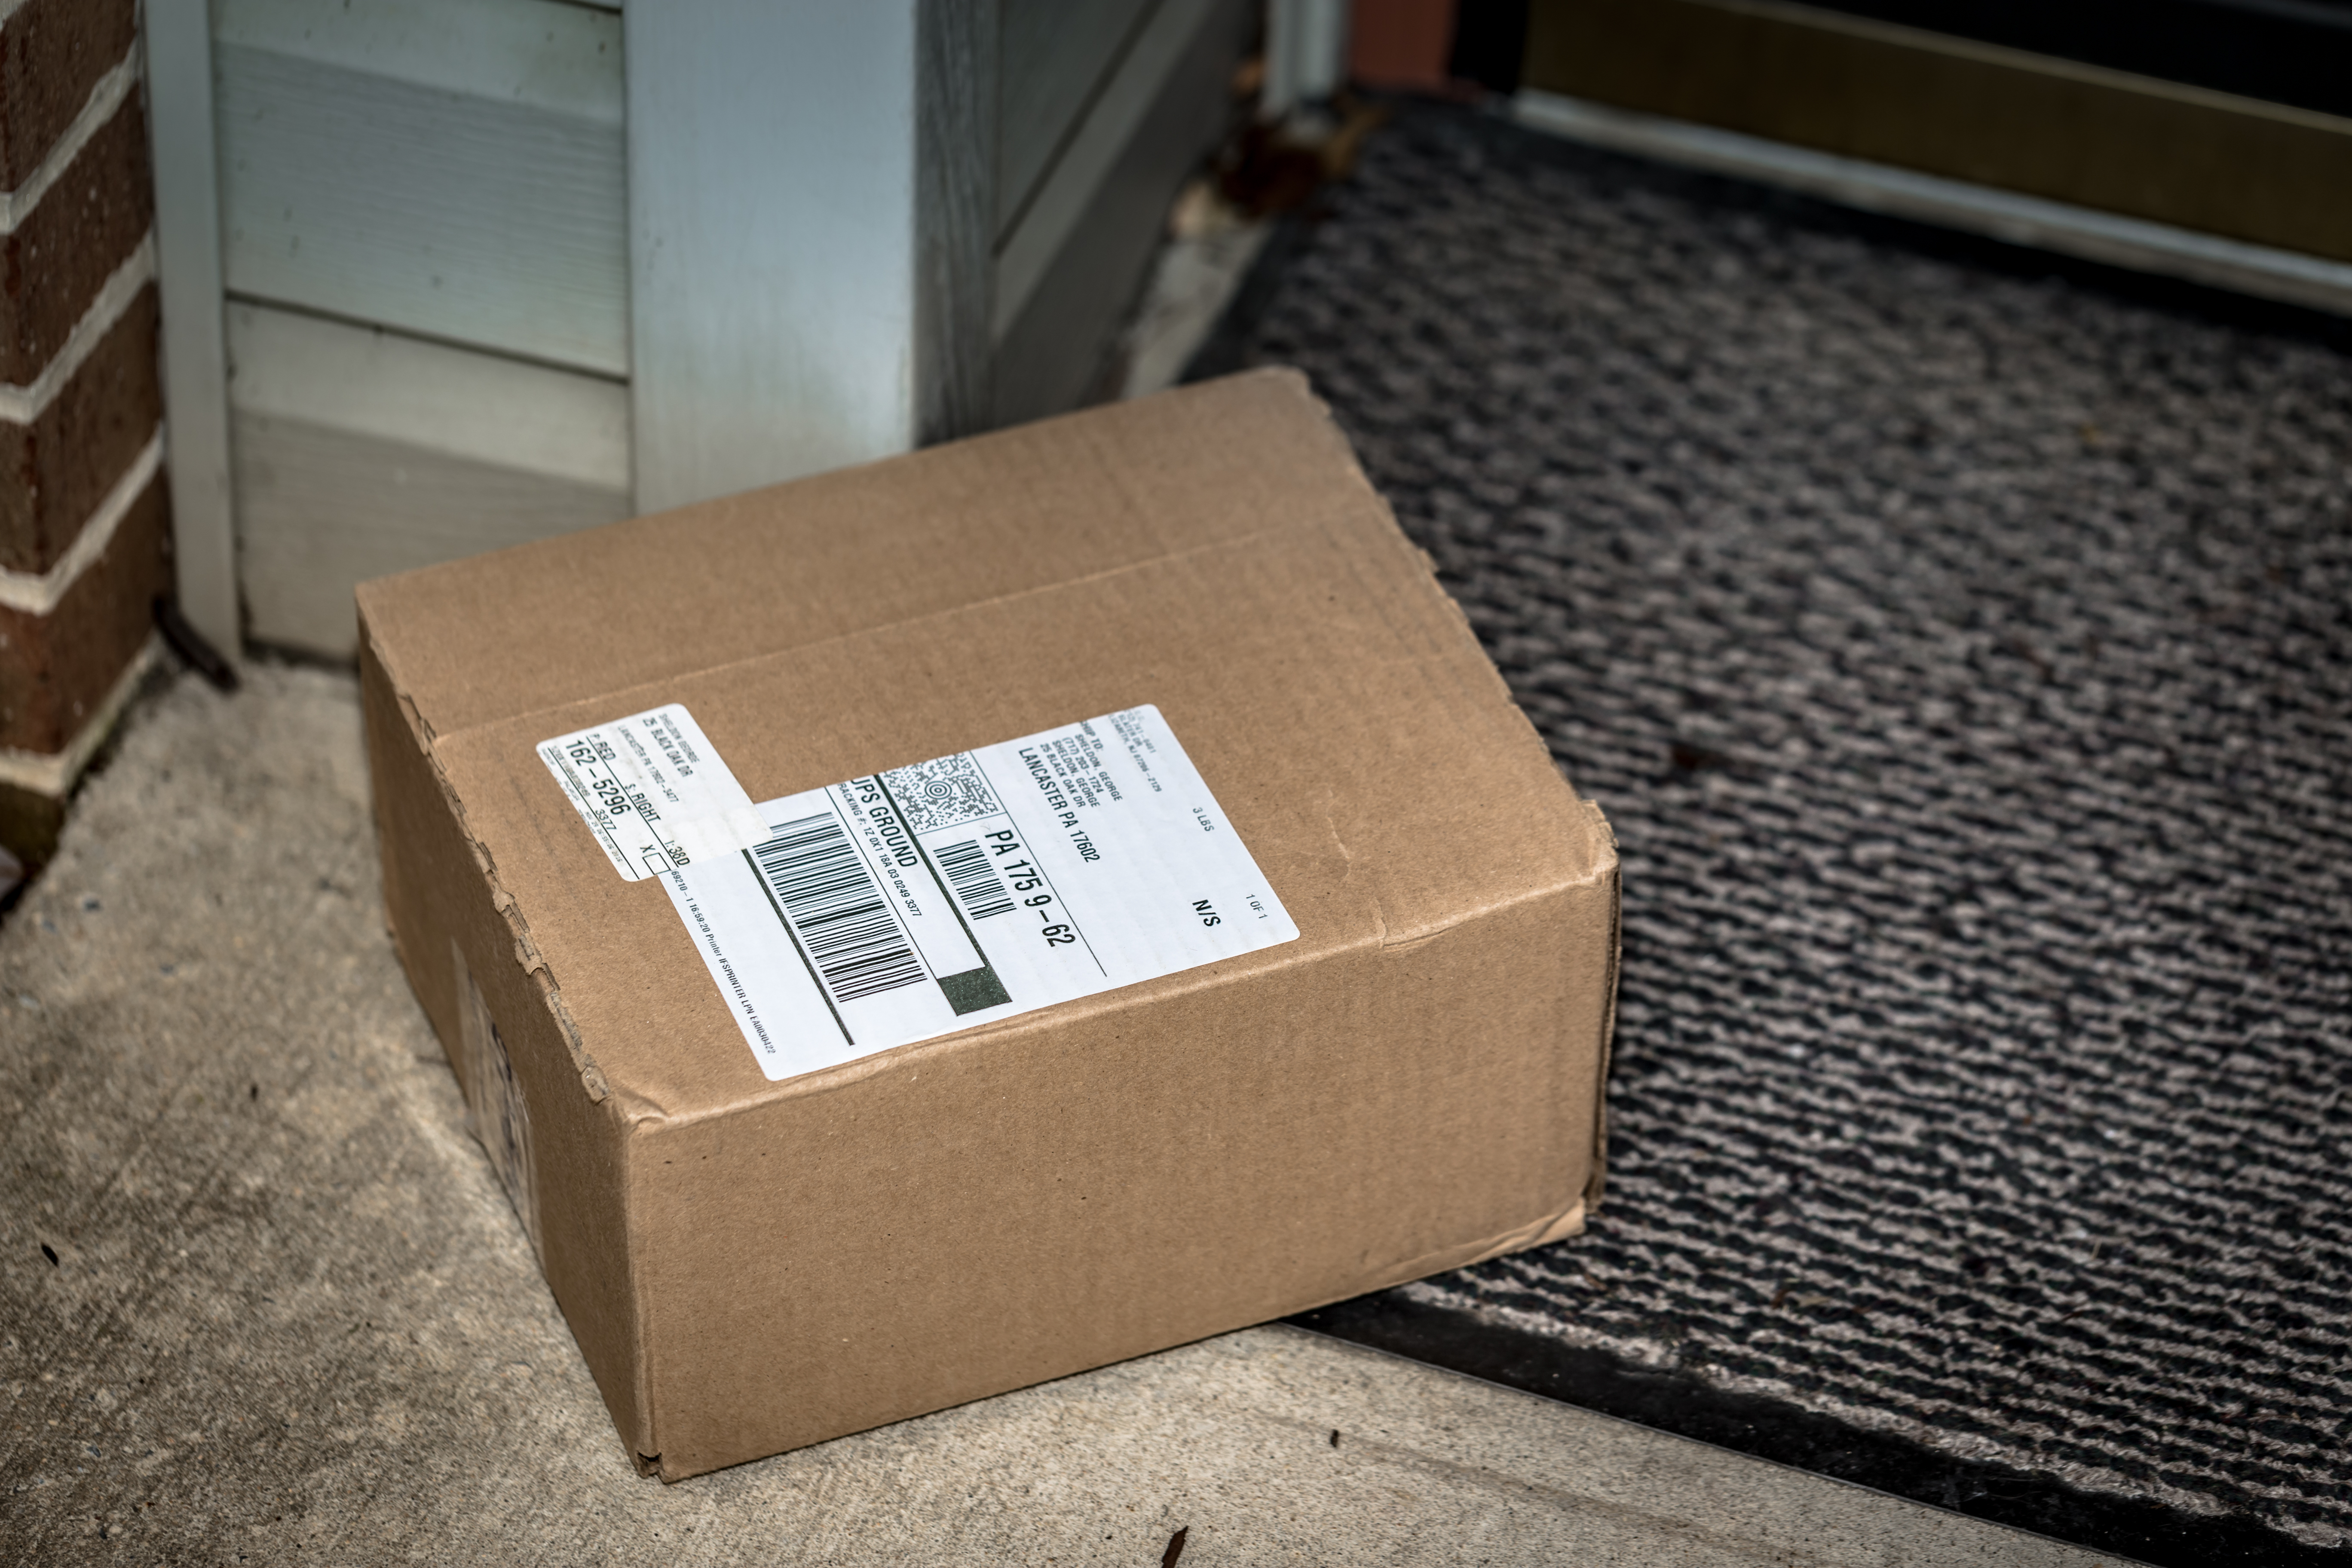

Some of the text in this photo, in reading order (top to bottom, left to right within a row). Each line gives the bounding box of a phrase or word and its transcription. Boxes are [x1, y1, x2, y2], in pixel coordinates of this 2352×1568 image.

[650, 728, 674, 751] BLACK
[666, 750, 686, 766] OAK
[677, 765, 694, 778] DR
[1061, 737, 1080, 756] (717)
[1090, 738, 1104, 750] TO:
[1127, 744, 1138, 753] NJ
[1039, 743, 1087, 808] 25 BLACK OAK DR
[1051, 739, 1101, 808] SHELDON, GEORGE
[1074, 733, 1123, 802] SHELDON, GEORGE
[566, 740, 632, 815] 162-5296
[639, 844, 656, 854] X
[594, 741, 616, 761] RED
[631, 792, 662, 822] RIGHT
[668, 846, 691, 866] 38D
[837, 782, 863, 816] RACKING
[1018, 747, 1101, 863] LANCASTER PA 17602
[594, 808, 617, 830] 3377
[863, 827, 876, 836] 1Z
[1197, 815, 1215, 832] LBS
[868, 806, 919, 867] GROUND
[869, 837, 884, 852] 0X1
[879, 853, 893, 868] 18A
[984, 829, 1021, 857] PA
[1003, 859, 1044, 891] 175
[887, 868, 900, 879] 03
[893, 879, 911, 898] 0249
[904, 899, 923, 916] 3377
[1191, 899, 1222, 927] N/S
[1250, 900, 1265, 912] OF
[670, 870, 694, 902] 69210-1
[689, 903, 711, 933] 16:59:20
[705, 933, 722, 956] Printer
[718, 958, 747, 999] IFSPRINTER
[741, 999, 755, 1014] LPN
